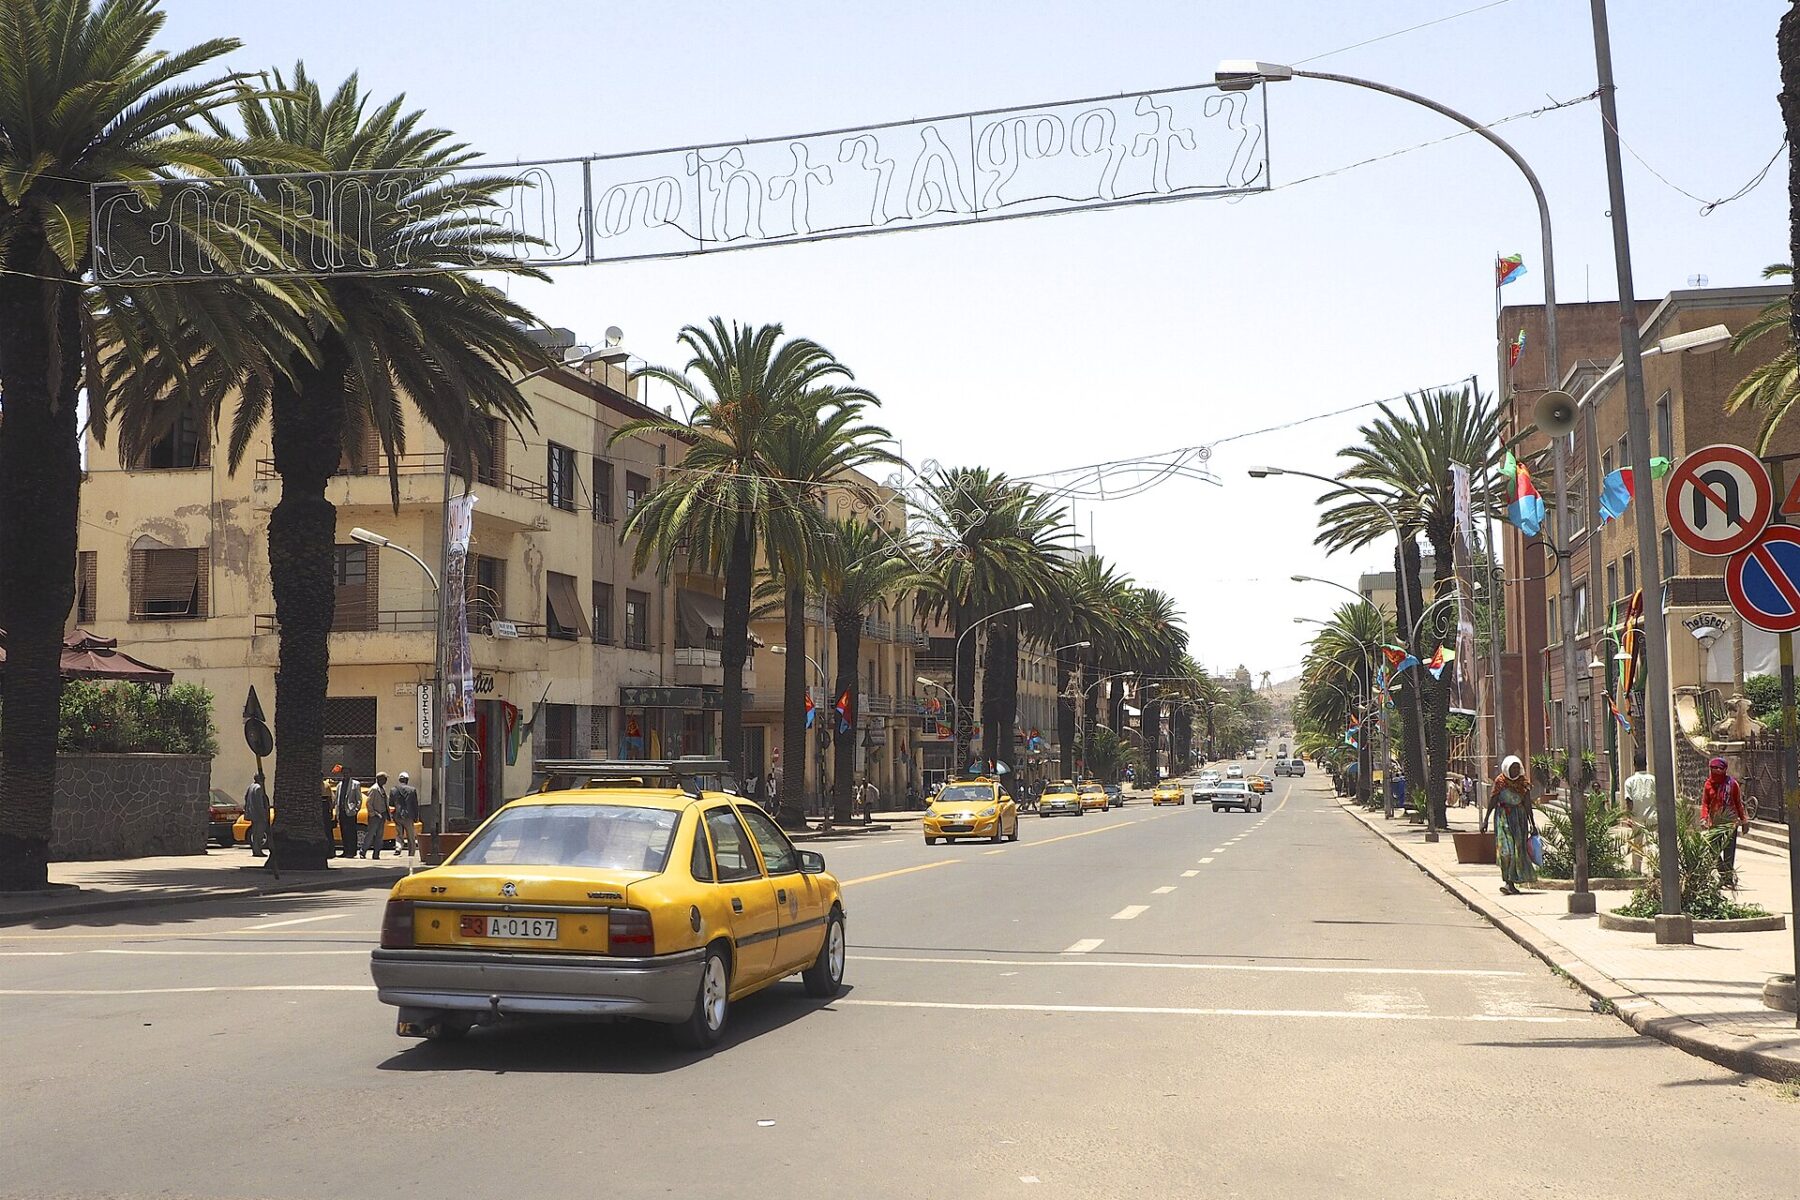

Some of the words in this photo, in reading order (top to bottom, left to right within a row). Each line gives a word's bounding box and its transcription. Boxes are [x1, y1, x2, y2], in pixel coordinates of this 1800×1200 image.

[594, 134, 895, 242] መኸተን
[906, 92, 1262, 219] ልምዓትን
[1685, 614, 1727, 630] hotspot
